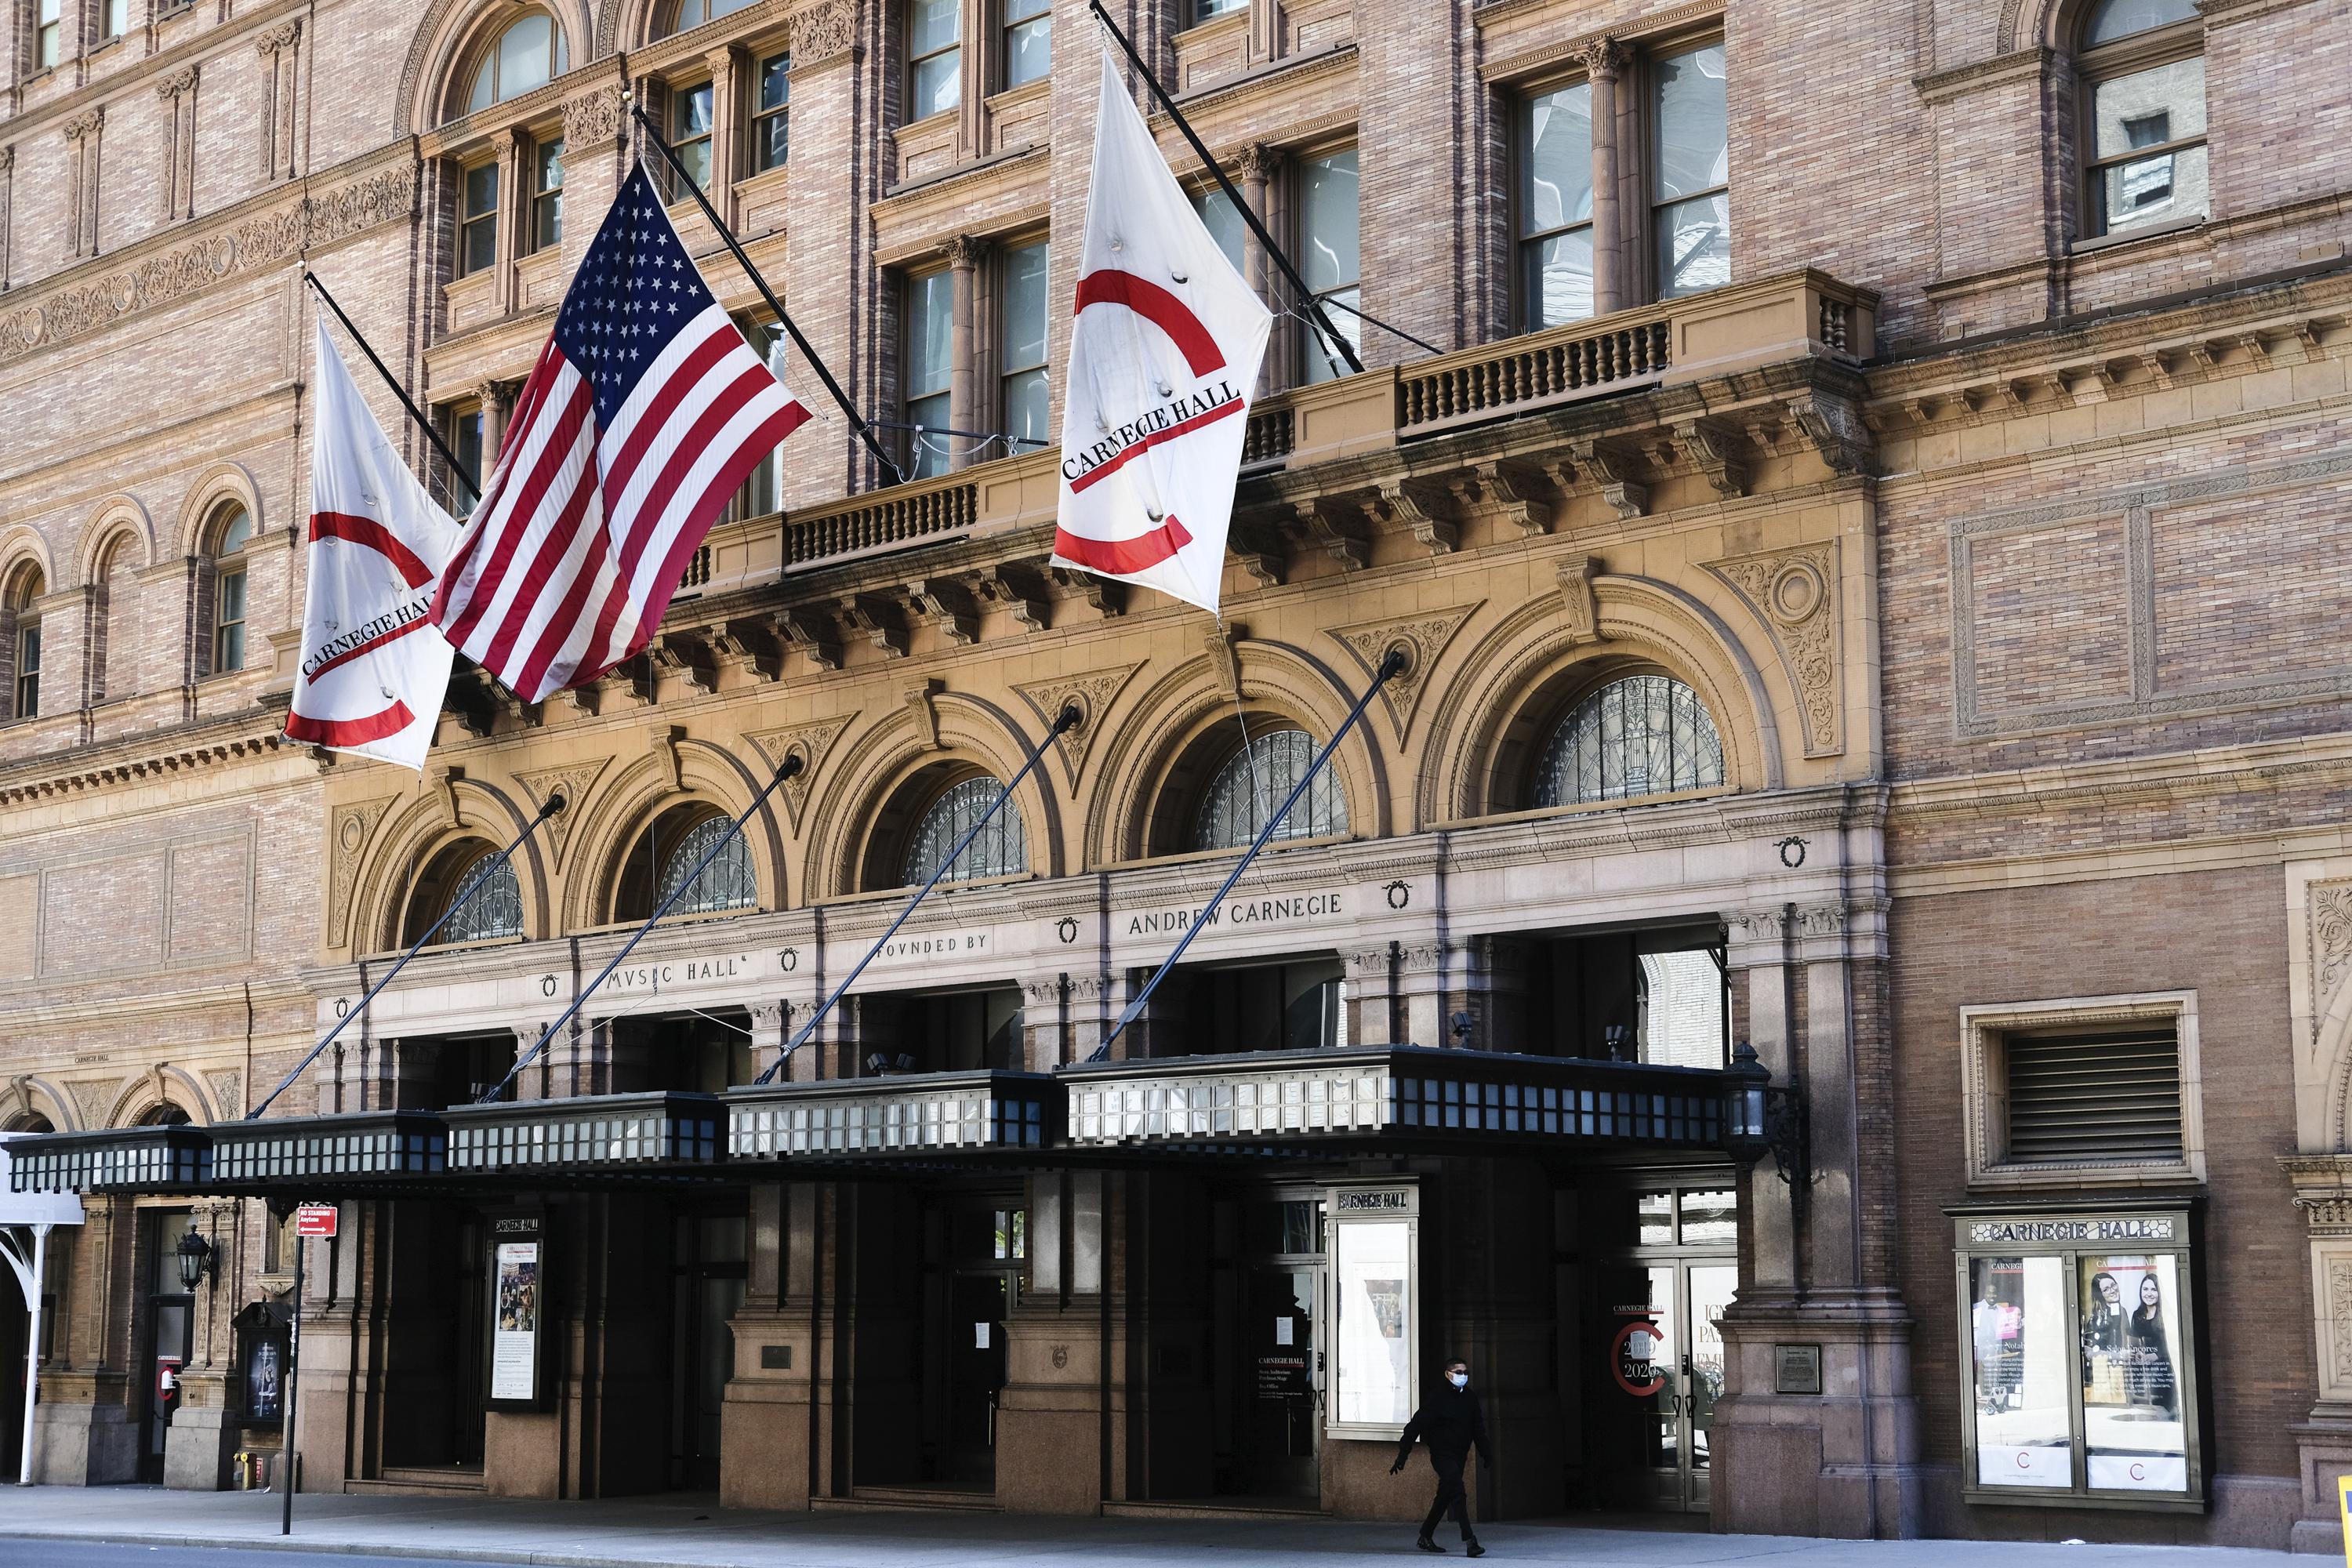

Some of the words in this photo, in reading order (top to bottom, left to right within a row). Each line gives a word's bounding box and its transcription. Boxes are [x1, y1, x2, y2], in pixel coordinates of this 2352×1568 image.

[1062, 408, 1170, 480] CARNEGIE
[1170, 380, 1241, 423] HALL
[302, 613, 396, 676] CARNEGIE
[395, 590, 437, 626] HAL
[1231, 894, 1342, 923] CARNEGIE
[967, 935, 985, 949] BY
[607, 967, 672, 989] MVSIC
[1384, 1192, 1406, 1208] HALL
[1990, 1223, 2088, 1242] CARNEGIE
[2099, 1220, 2152, 1240] HALL
[1624, 1341, 1656, 1356] 2019
[1624, 1363, 1657, 1377] 2020
